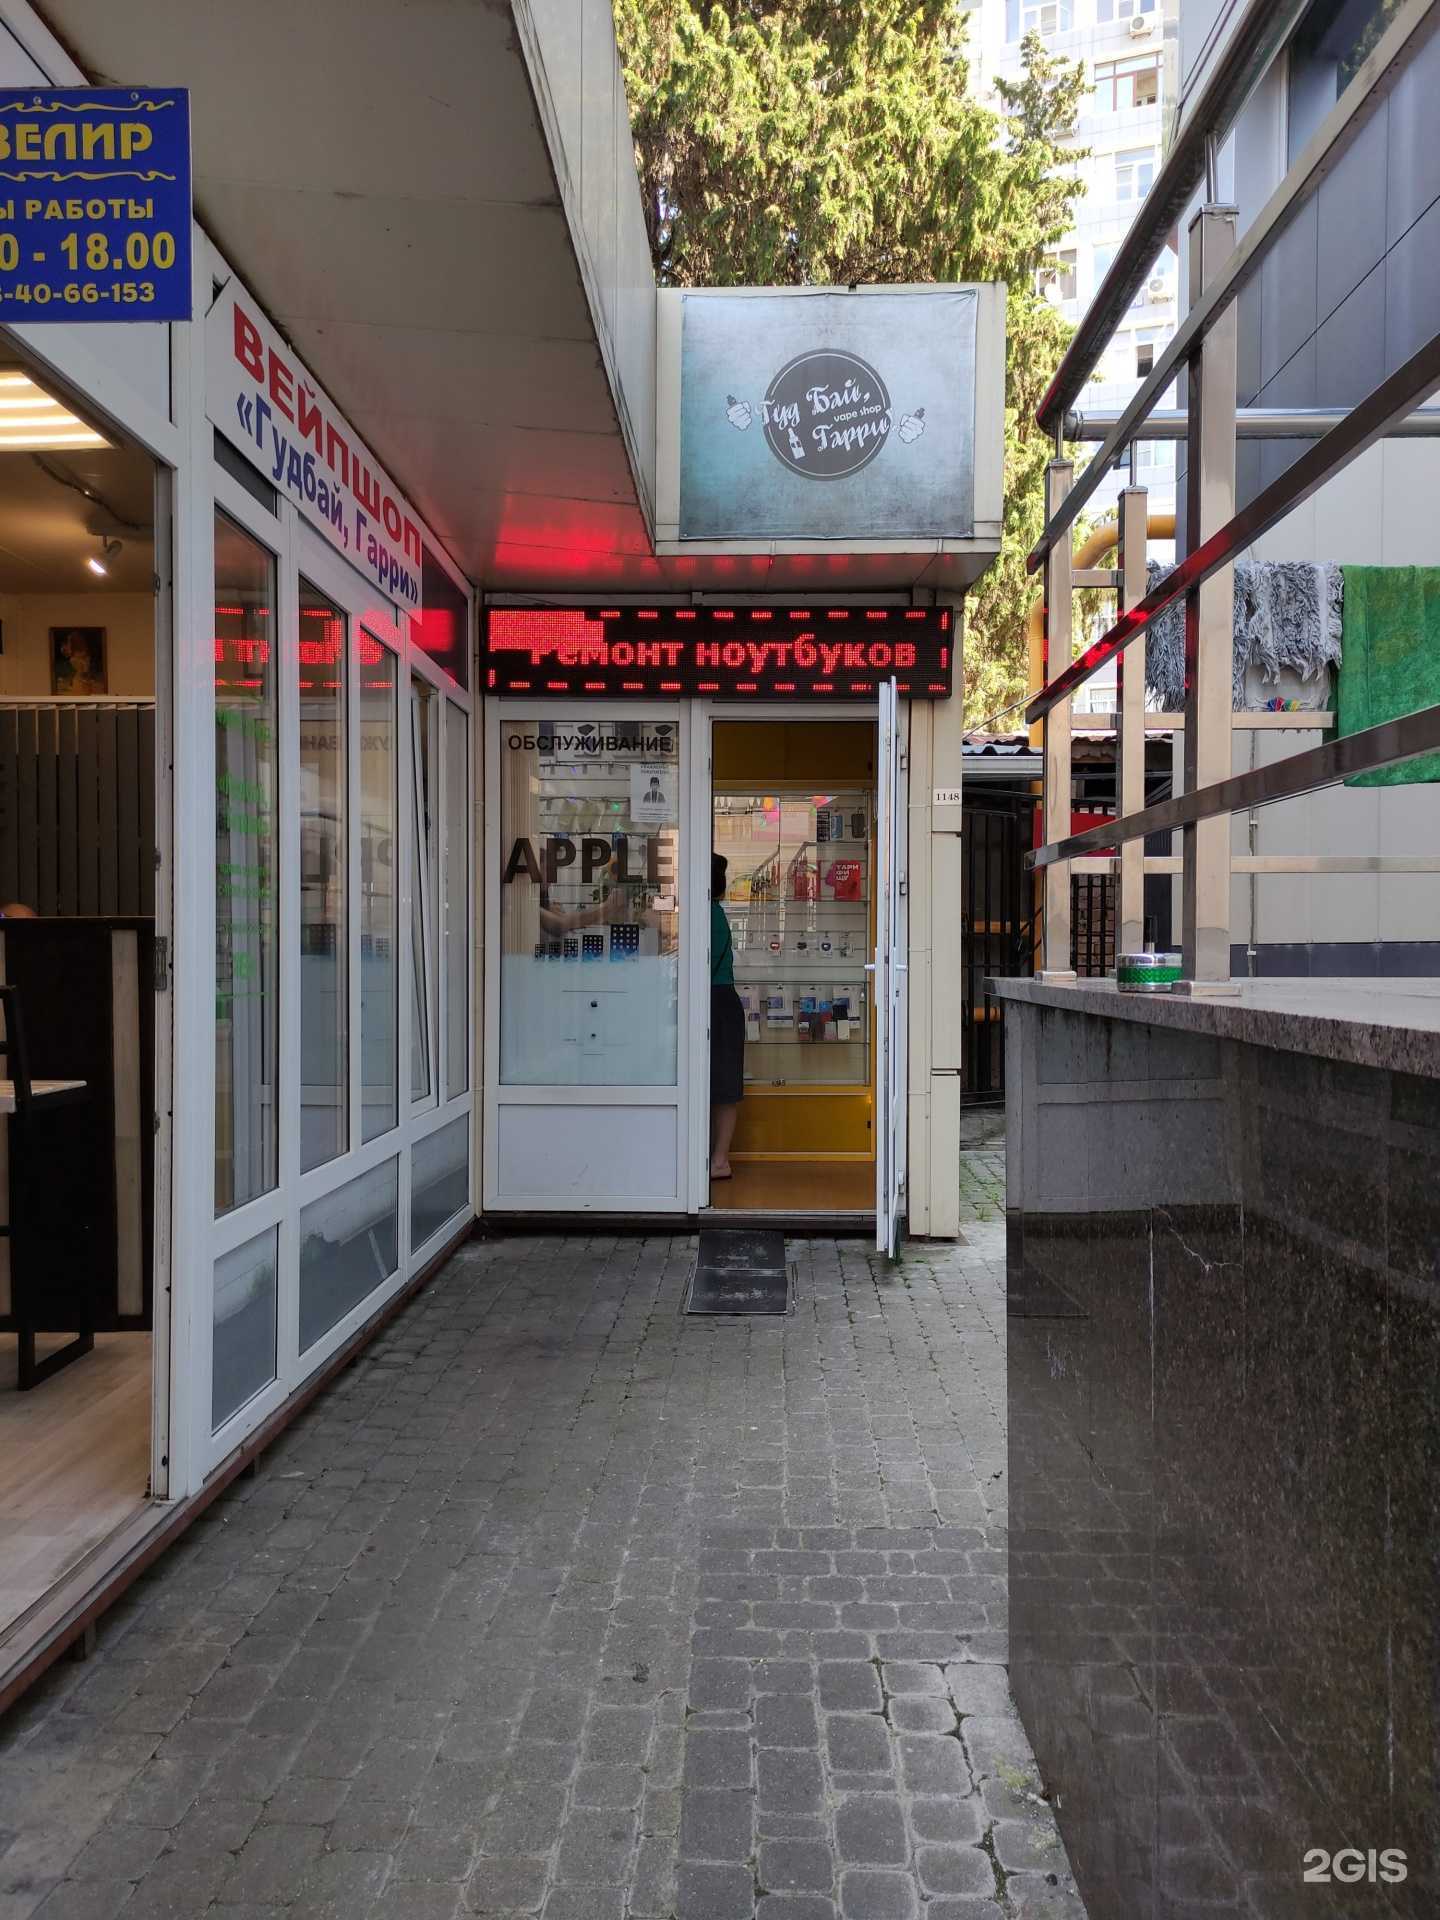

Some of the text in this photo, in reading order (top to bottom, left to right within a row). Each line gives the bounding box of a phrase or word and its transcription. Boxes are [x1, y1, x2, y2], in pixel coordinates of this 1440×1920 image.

[25, 198, 154, 220] РАБОТЫ
[60, 231, 176, 271] 18.00
[0, 282, 155, 304] -40-66-153
[806, 377, 871, 416] Бай,
[833, 404, 882, 423] vape shop
[756, 399, 801, 430] Гуд
[233, 301, 423, 569] ВЕЙПШОП
[236, 390, 418, 606] «Гудбай, Гарри»
[696, 632, 917, 674] ноутбуков
[508, 734, 674, 753] ОБСЛУЖИВАНИЕ
[936, 792, 961, 801] 1148
[503, 837, 674, 884] APPLE
